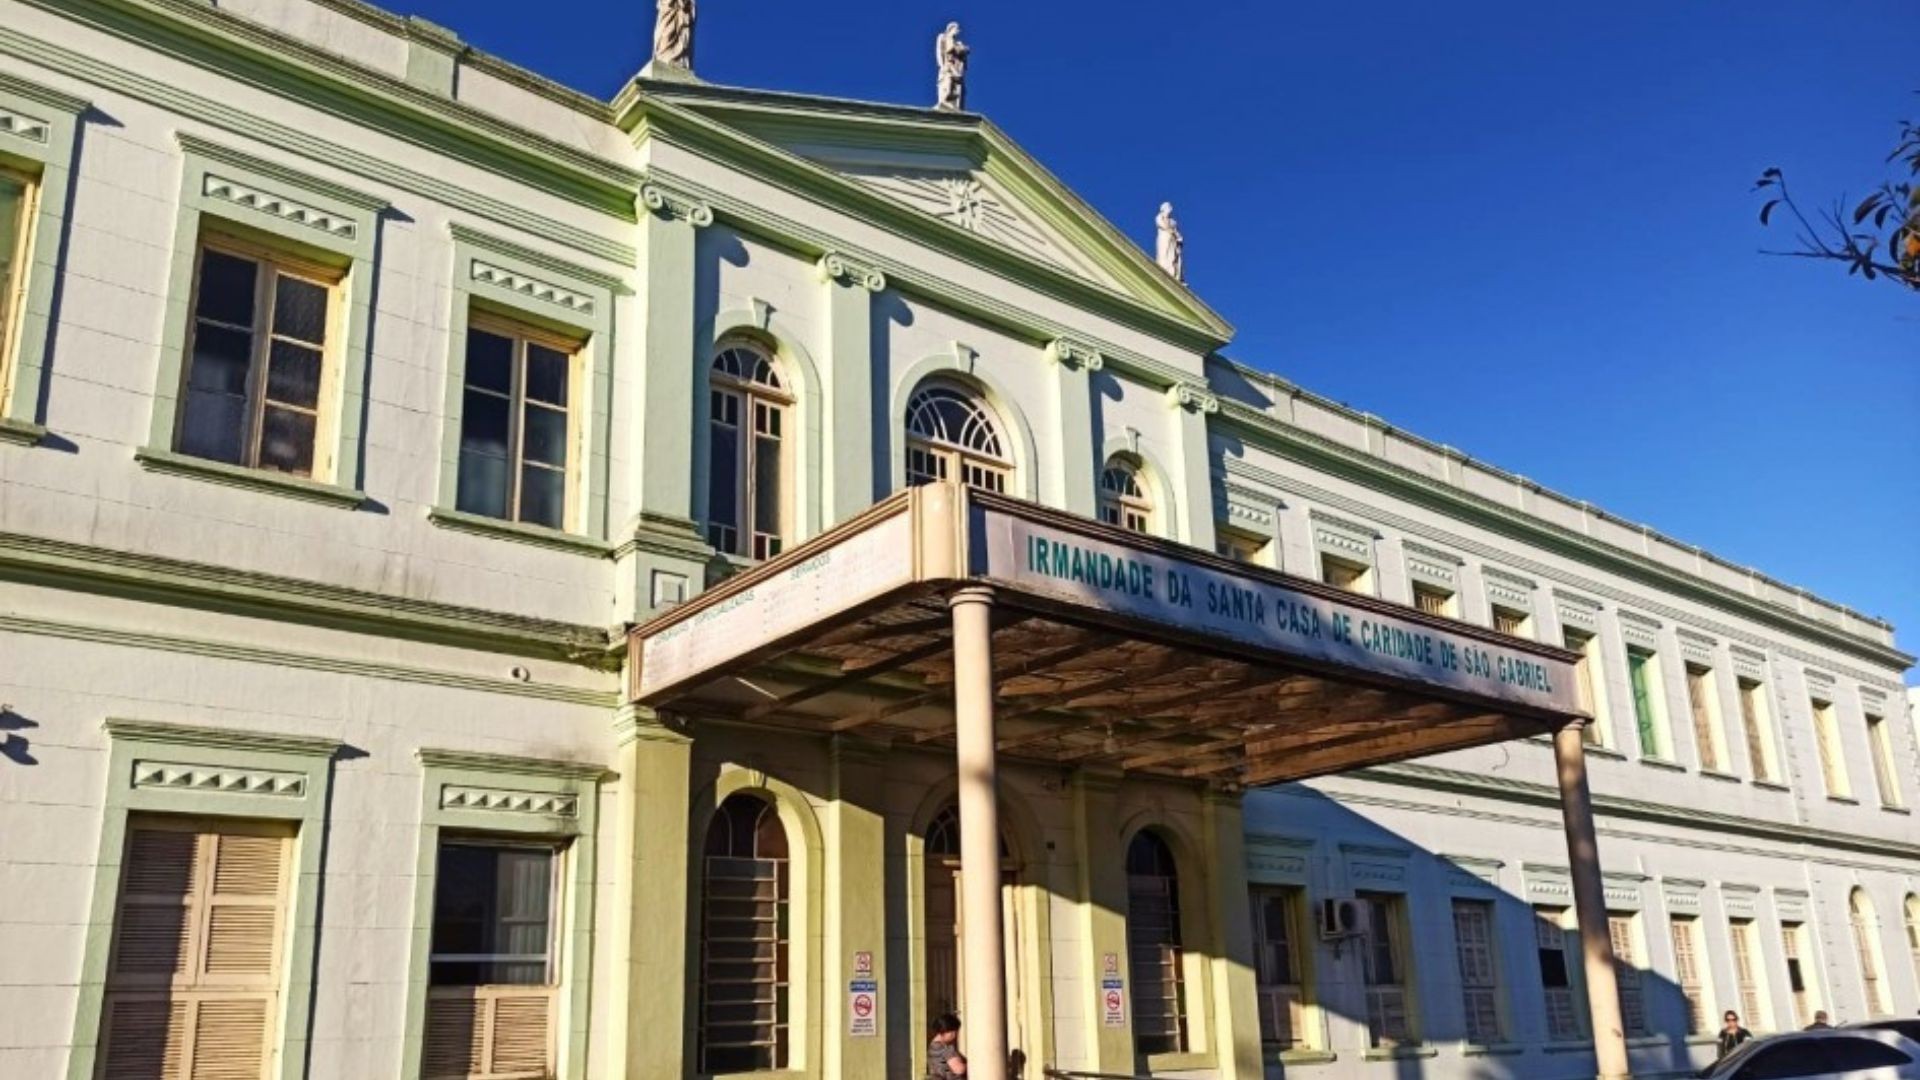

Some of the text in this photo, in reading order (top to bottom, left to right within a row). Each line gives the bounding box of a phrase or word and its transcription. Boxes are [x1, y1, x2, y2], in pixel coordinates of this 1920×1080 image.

[1028, 535, 1552, 693] IRMANDADE DA SANTA CASA DE CARIDADE DE SÃO GABRIEL
